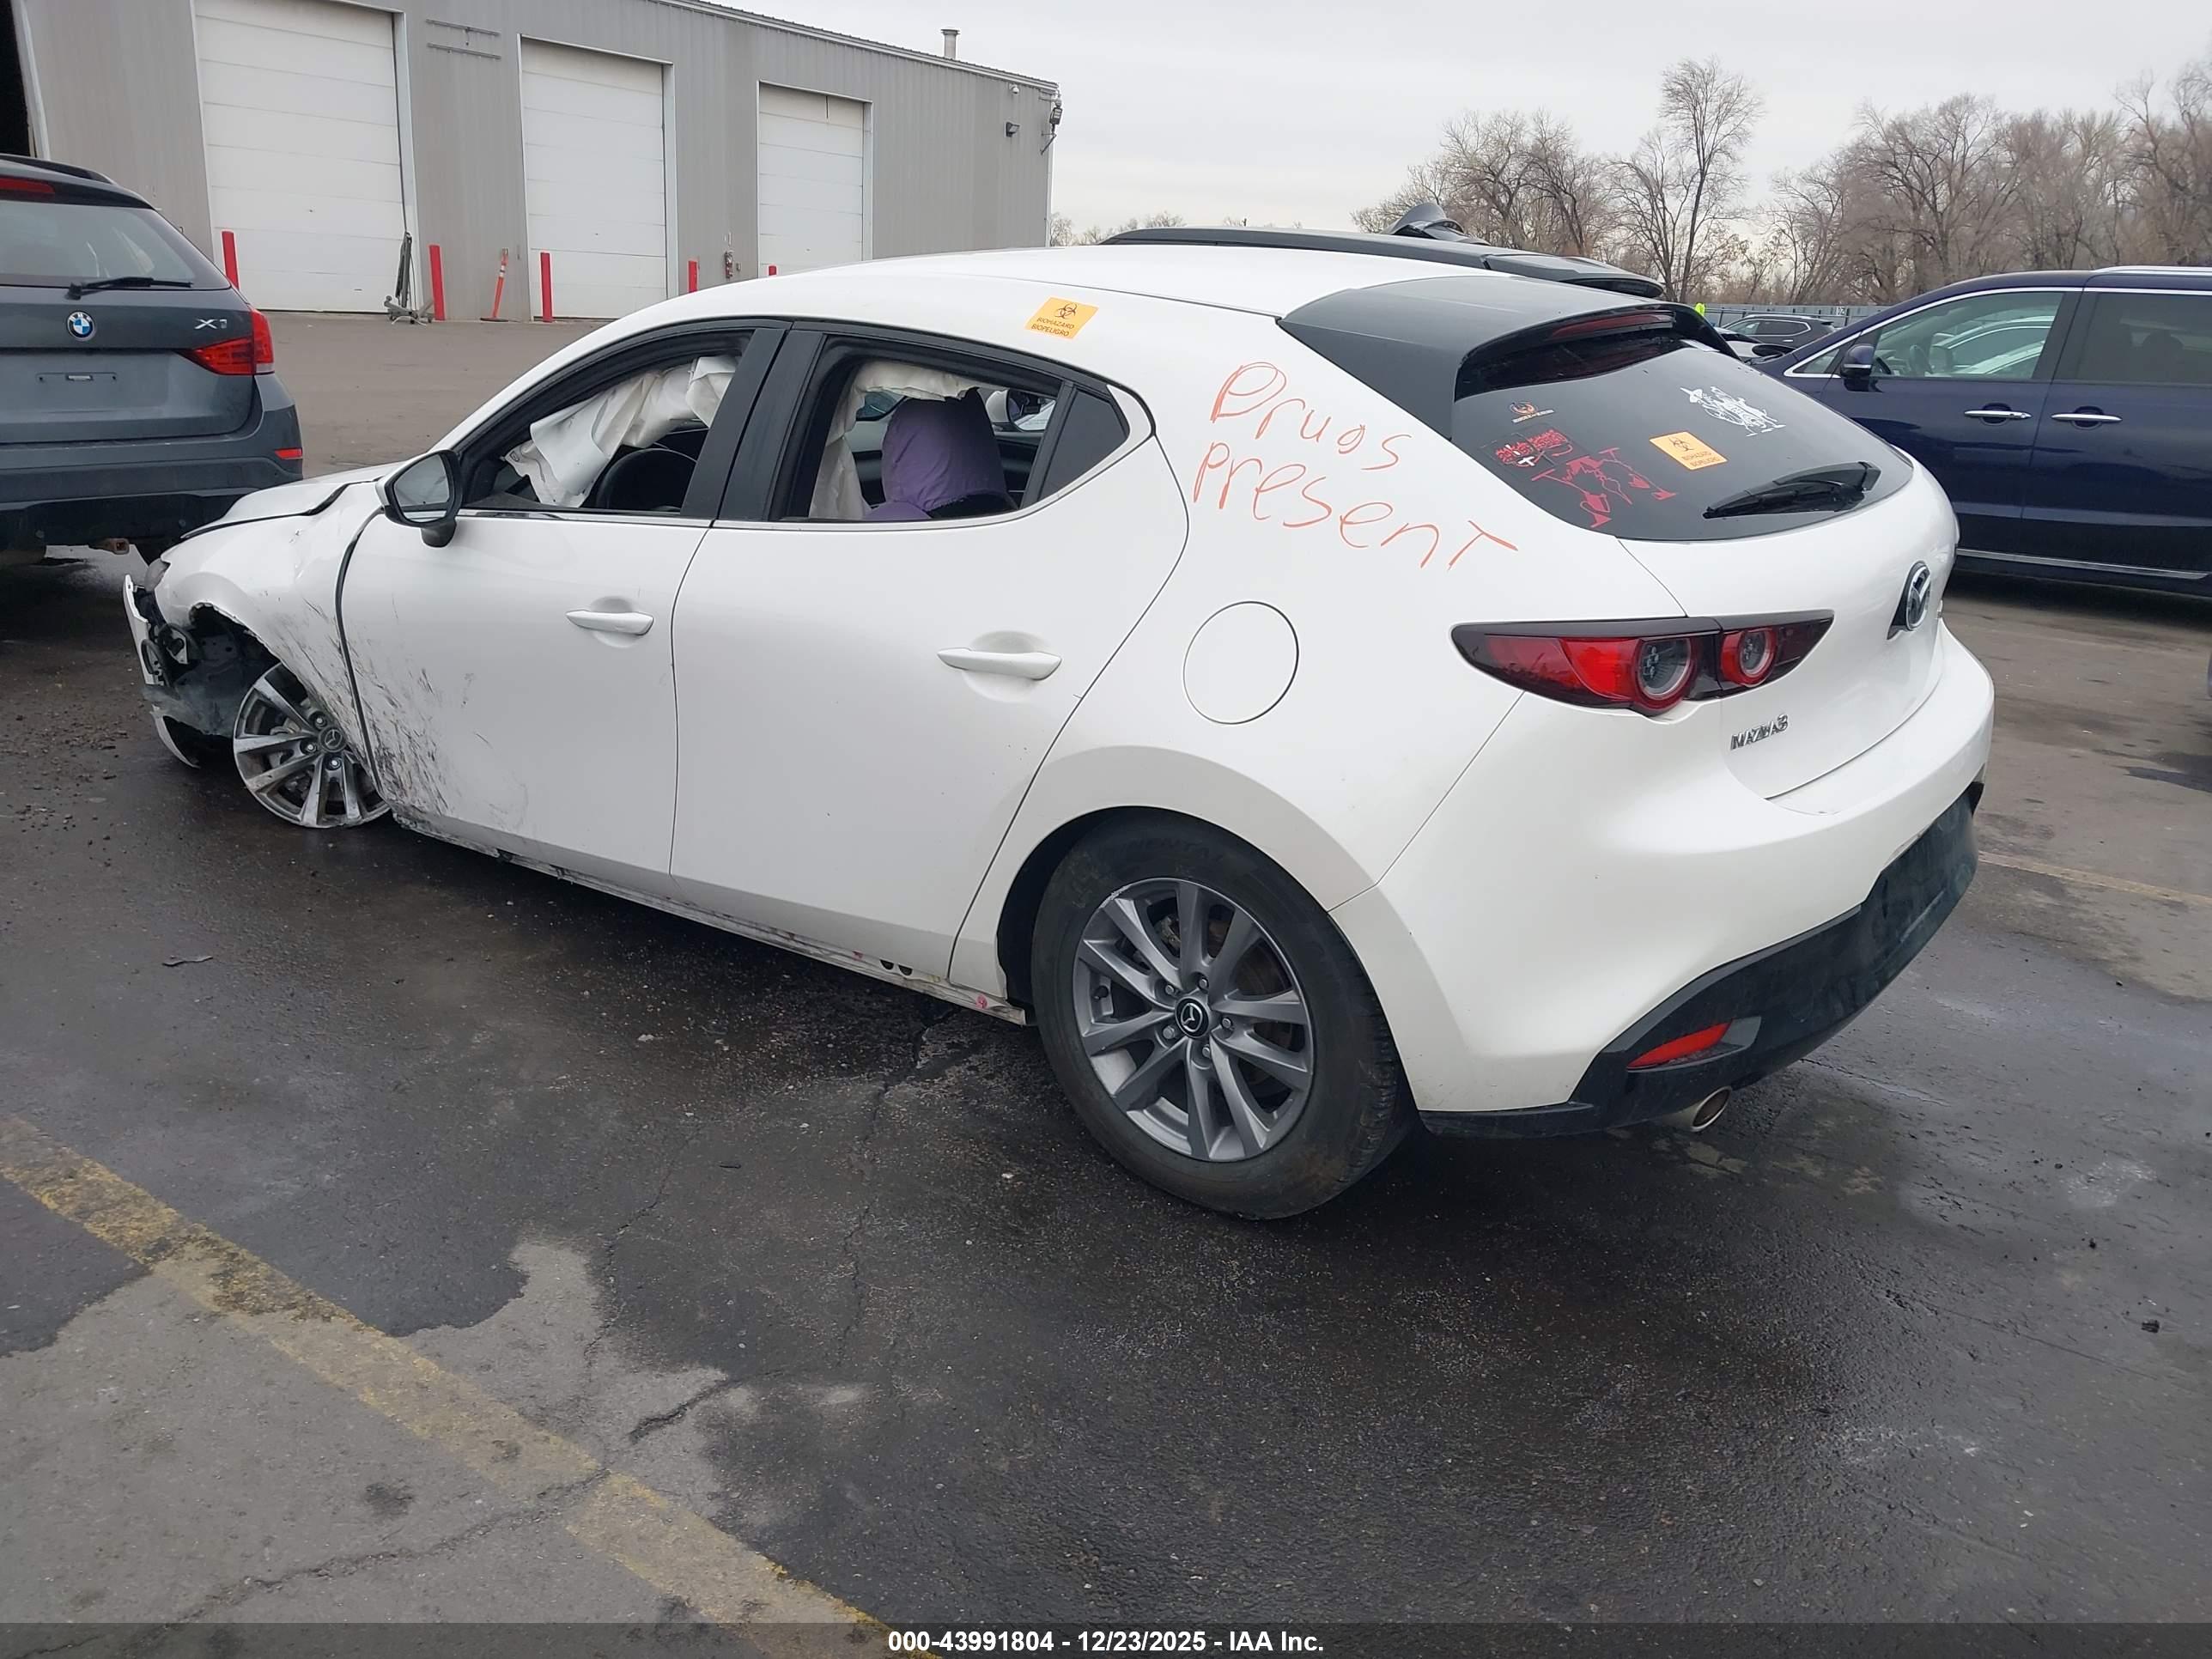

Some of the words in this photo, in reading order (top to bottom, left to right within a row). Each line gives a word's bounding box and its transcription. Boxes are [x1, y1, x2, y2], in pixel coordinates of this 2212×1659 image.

[194, 319, 228, 330] X1
[1030, 323, 1070, 337] BIOPELIGRO
[1036, 317, 1075, 330] BIOHAZARD
